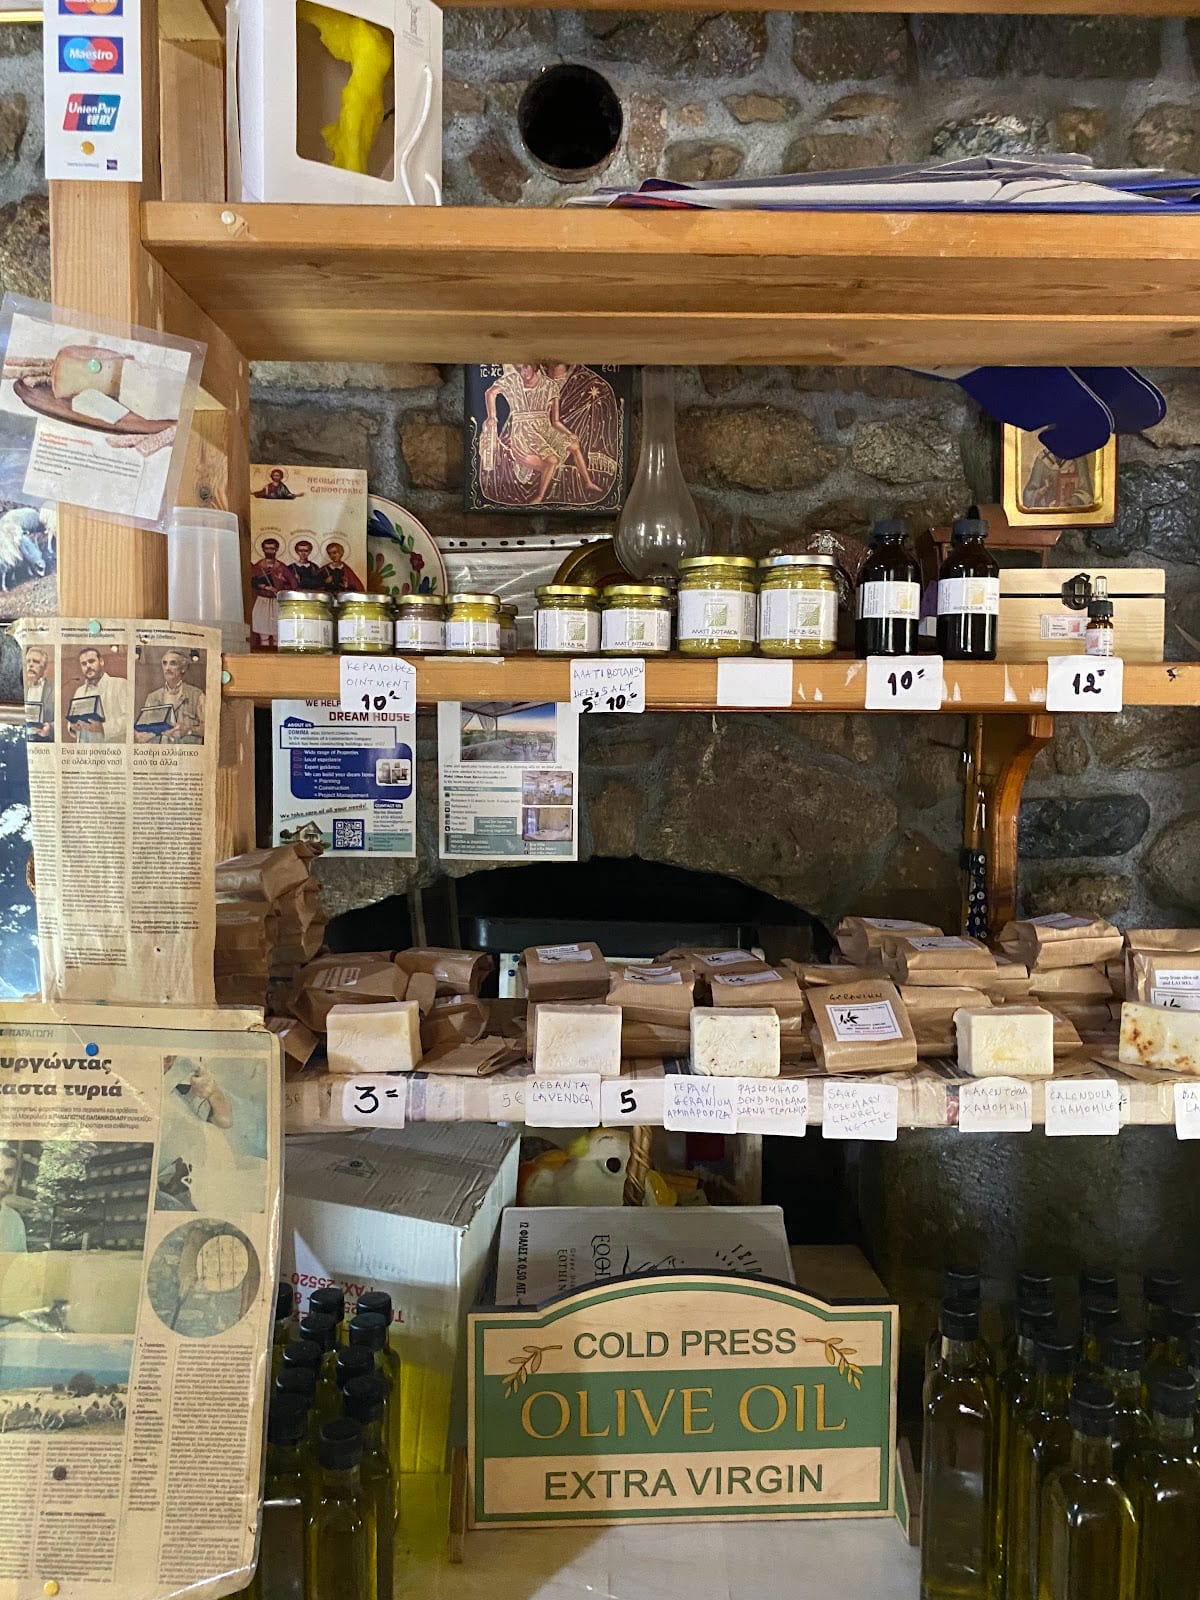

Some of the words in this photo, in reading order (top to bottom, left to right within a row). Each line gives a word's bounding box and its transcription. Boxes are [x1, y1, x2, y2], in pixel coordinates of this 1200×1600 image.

[69, 49, 113, 60] Maestro
[69, 102, 116, 118] UnionPay
[346, 677, 410, 690] OINTMENT
[329, 712, 368, 721] DREAM
[373, 713, 410, 722] HOUSE
[64, 1079, 122, 1100] τυριά
[1050, 1089, 1112, 1101] CALENDULA
[532, 1092, 594, 1110] LAVENDER
[620, 1089, 637, 1113] 5
[675, 1098, 733, 1112] GERANIUM
[828, 1095, 880, 1111] ROSEMARY
[832, 1107, 880, 1123] LAUREL
[1052, 1103, 1113, 1116] CHAMOMILE
[573, 1332, 669, 1360] COLD
[681, 1328, 797, 1356] PRESS
[521, 1387, 715, 1439] OLIVE
[739, 1383, 847, 1434] OIL
[545, 1468, 677, 1500] EXTRA
[686, 1464, 823, 1495] VIRGIN
